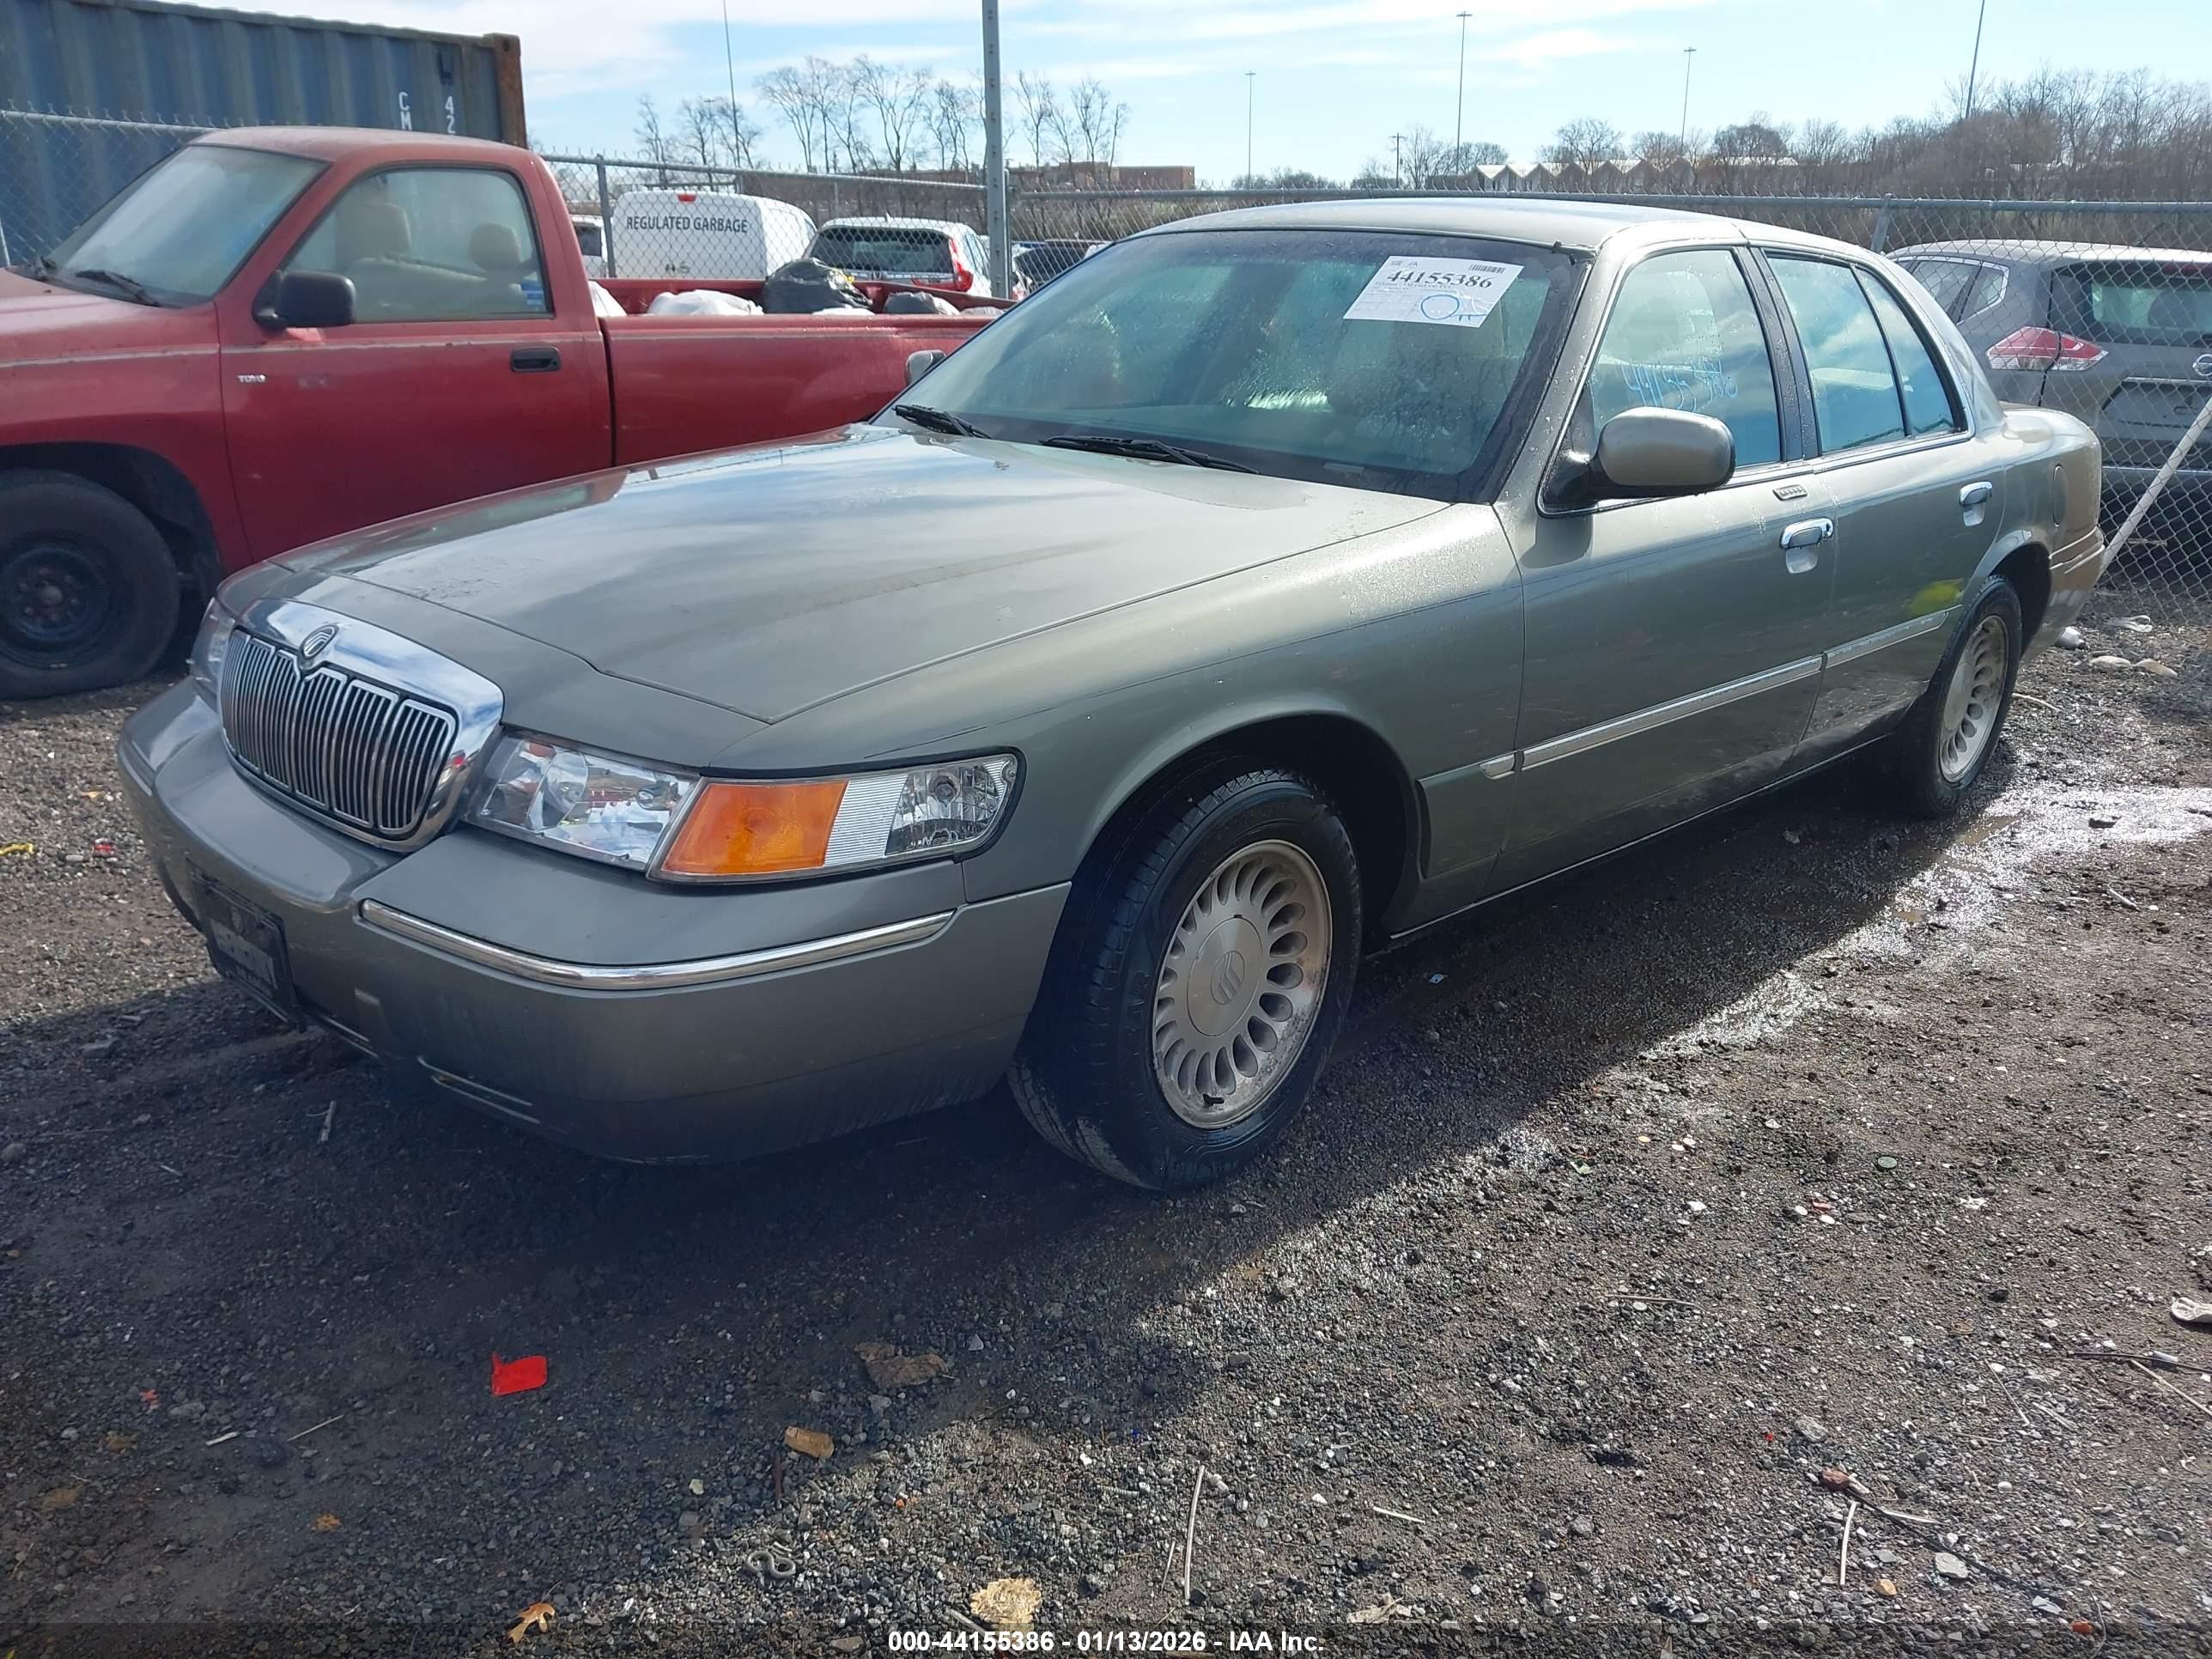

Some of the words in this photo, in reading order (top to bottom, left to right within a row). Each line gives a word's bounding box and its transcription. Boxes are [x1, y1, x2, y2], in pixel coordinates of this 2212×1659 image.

[626, 216, 690, 232] REGULATED
[693, 216, 749, 234] GARBAGE
[1387, 270, 1496, 289] 44155386
